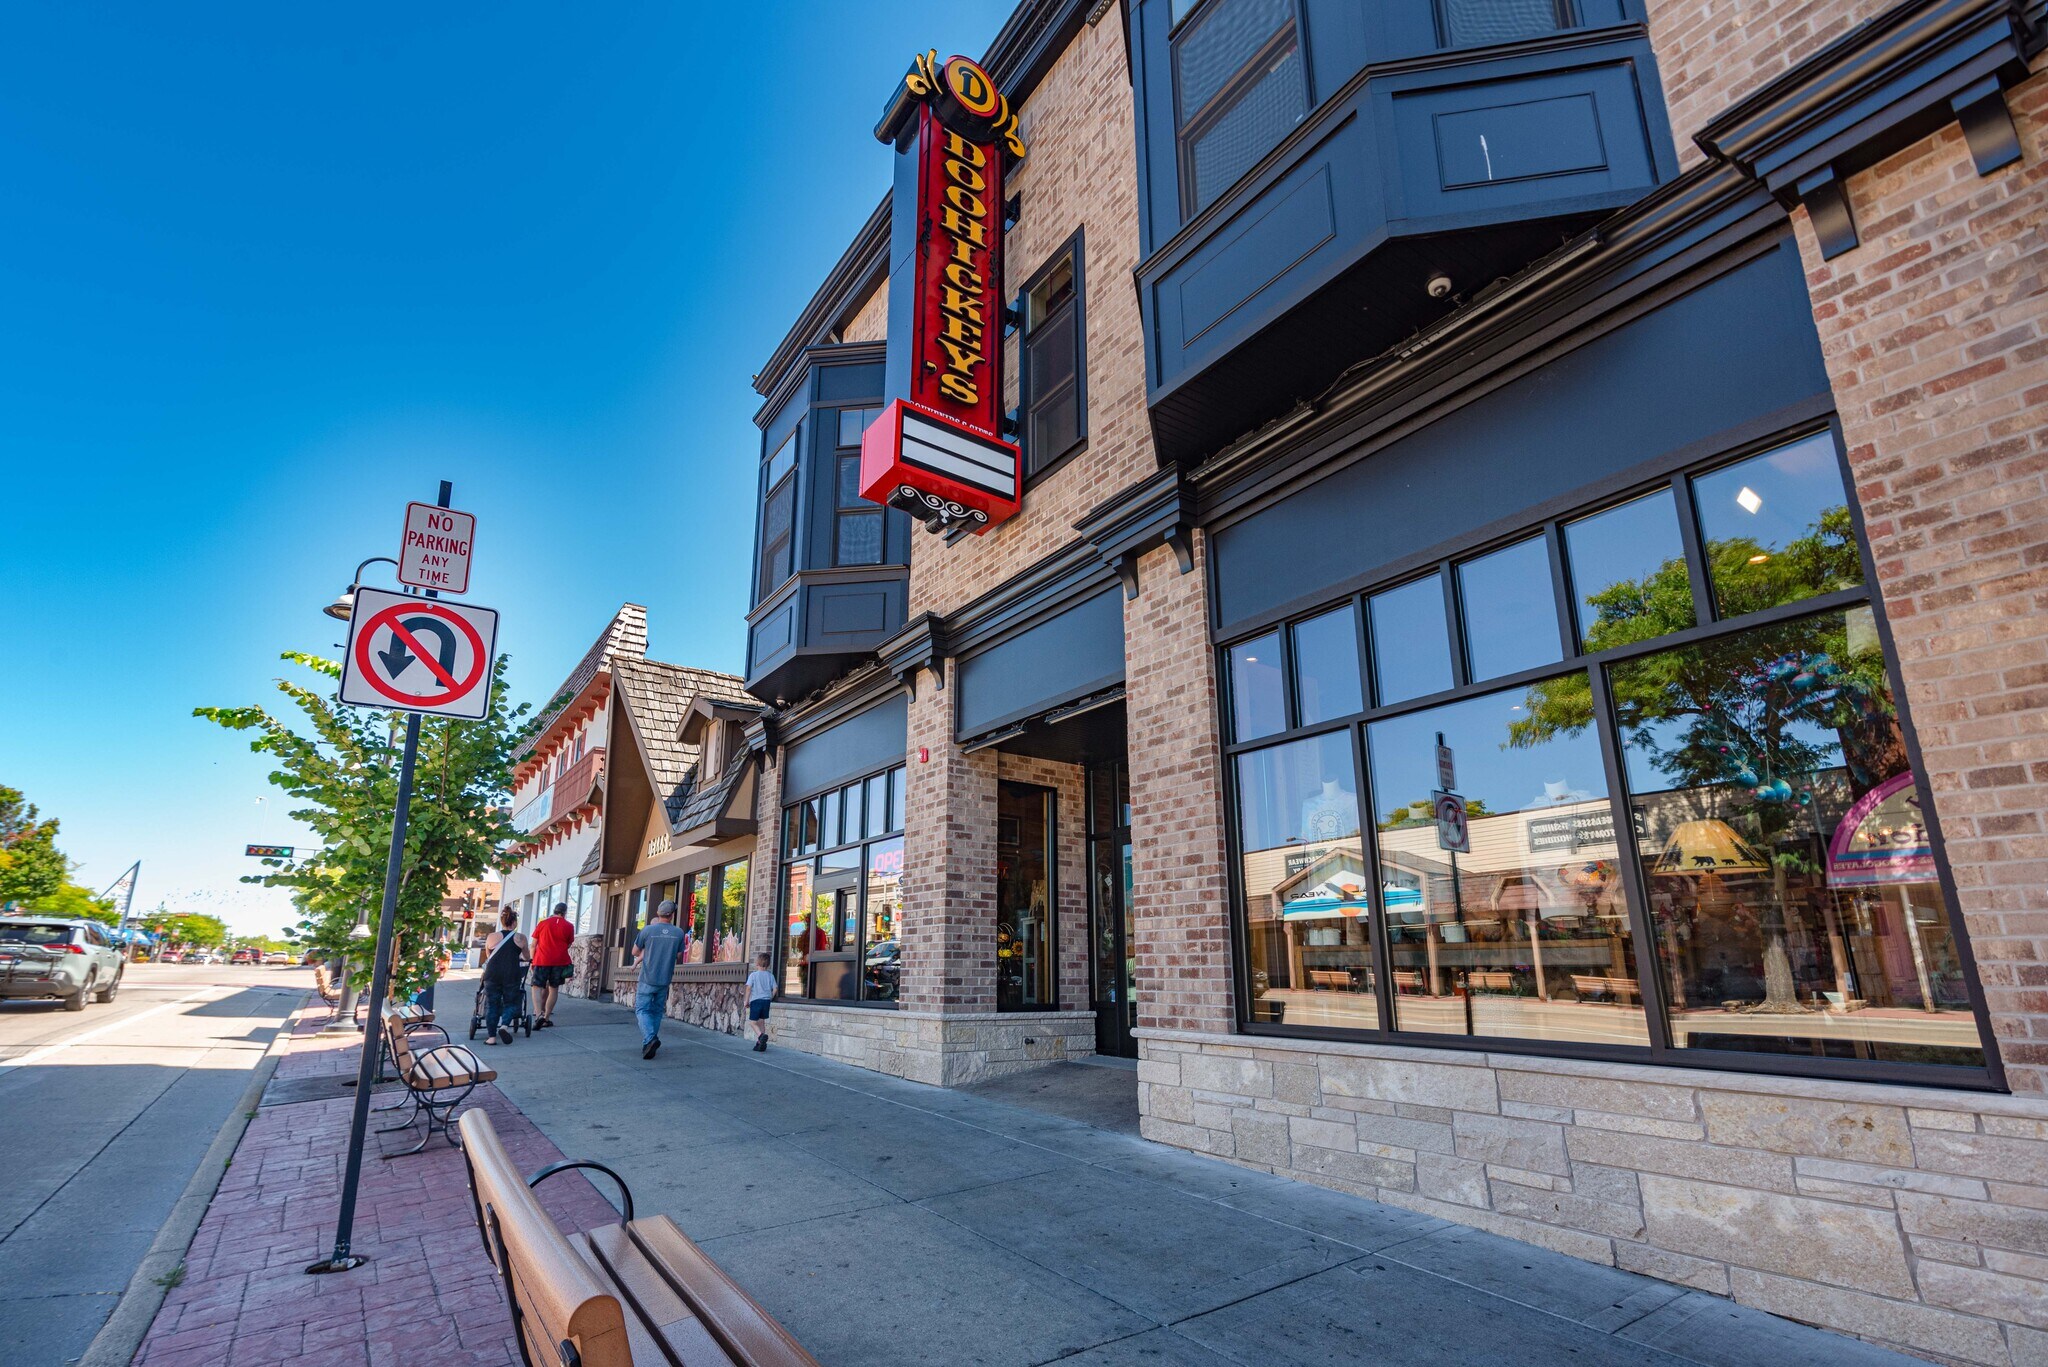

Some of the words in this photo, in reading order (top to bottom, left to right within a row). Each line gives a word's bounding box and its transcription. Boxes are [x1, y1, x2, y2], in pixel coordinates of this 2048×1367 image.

[957, 66, 988, 106] D
[427, 513, 454, 532] NO
[407, 530, 468, 556] PARKING
[421, 553, 450, 568] ANY
[419, 568, 450, 583] TIME
